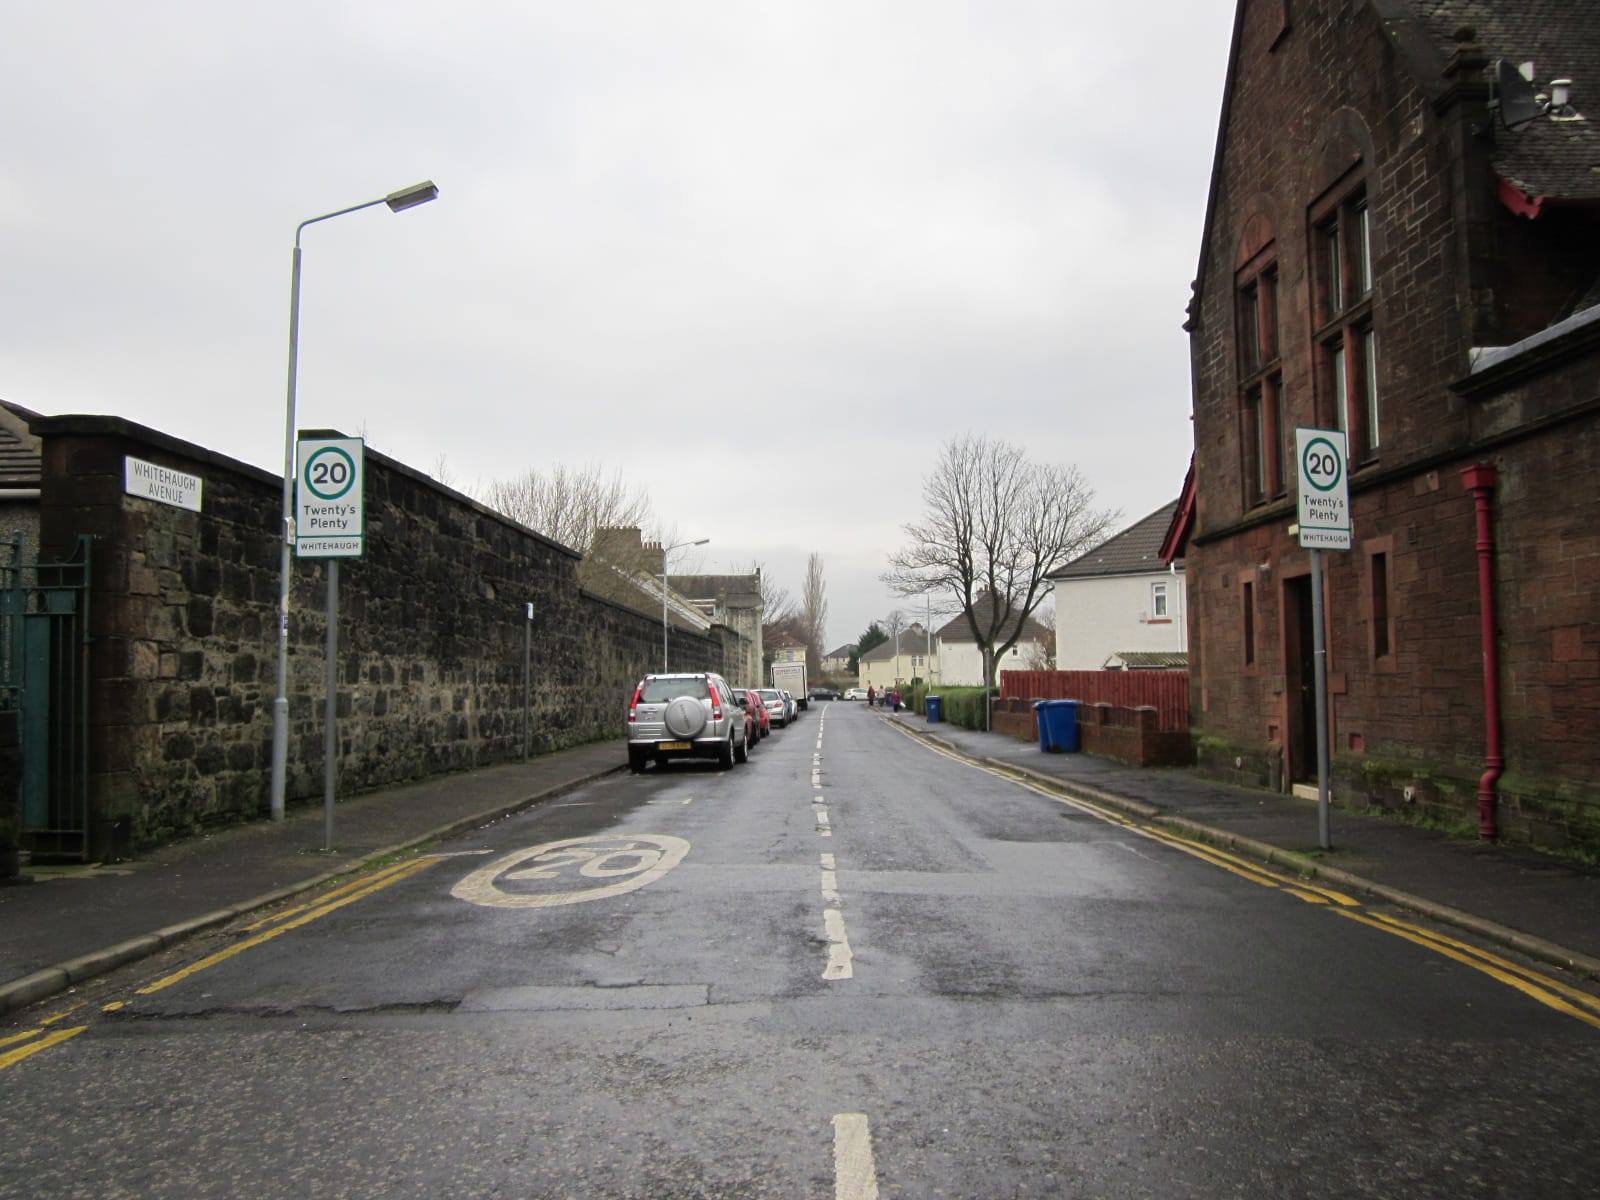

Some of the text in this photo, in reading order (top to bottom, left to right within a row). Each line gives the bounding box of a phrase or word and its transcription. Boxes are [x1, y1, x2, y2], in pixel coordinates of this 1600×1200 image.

[1309, 453, 1334, 475] 20
[134, 462, 196, 491] WHITEHAUGH
[313, 462, 347, 484] 20
[149, 483, 183, 504] AVENUE
[1304, 495, 1344, 509] Twenty's
[304, 505, 356, 516] Twenty's
[1309, 508, 1339, 522] Plenty
[310, 518, 348, 529] Plenty
[1303, 534, 1348, 543] WHITEHAUGH
[300, 542, 359, 550] WHITEHAUGH
[506, 849, 662, 879] 20
